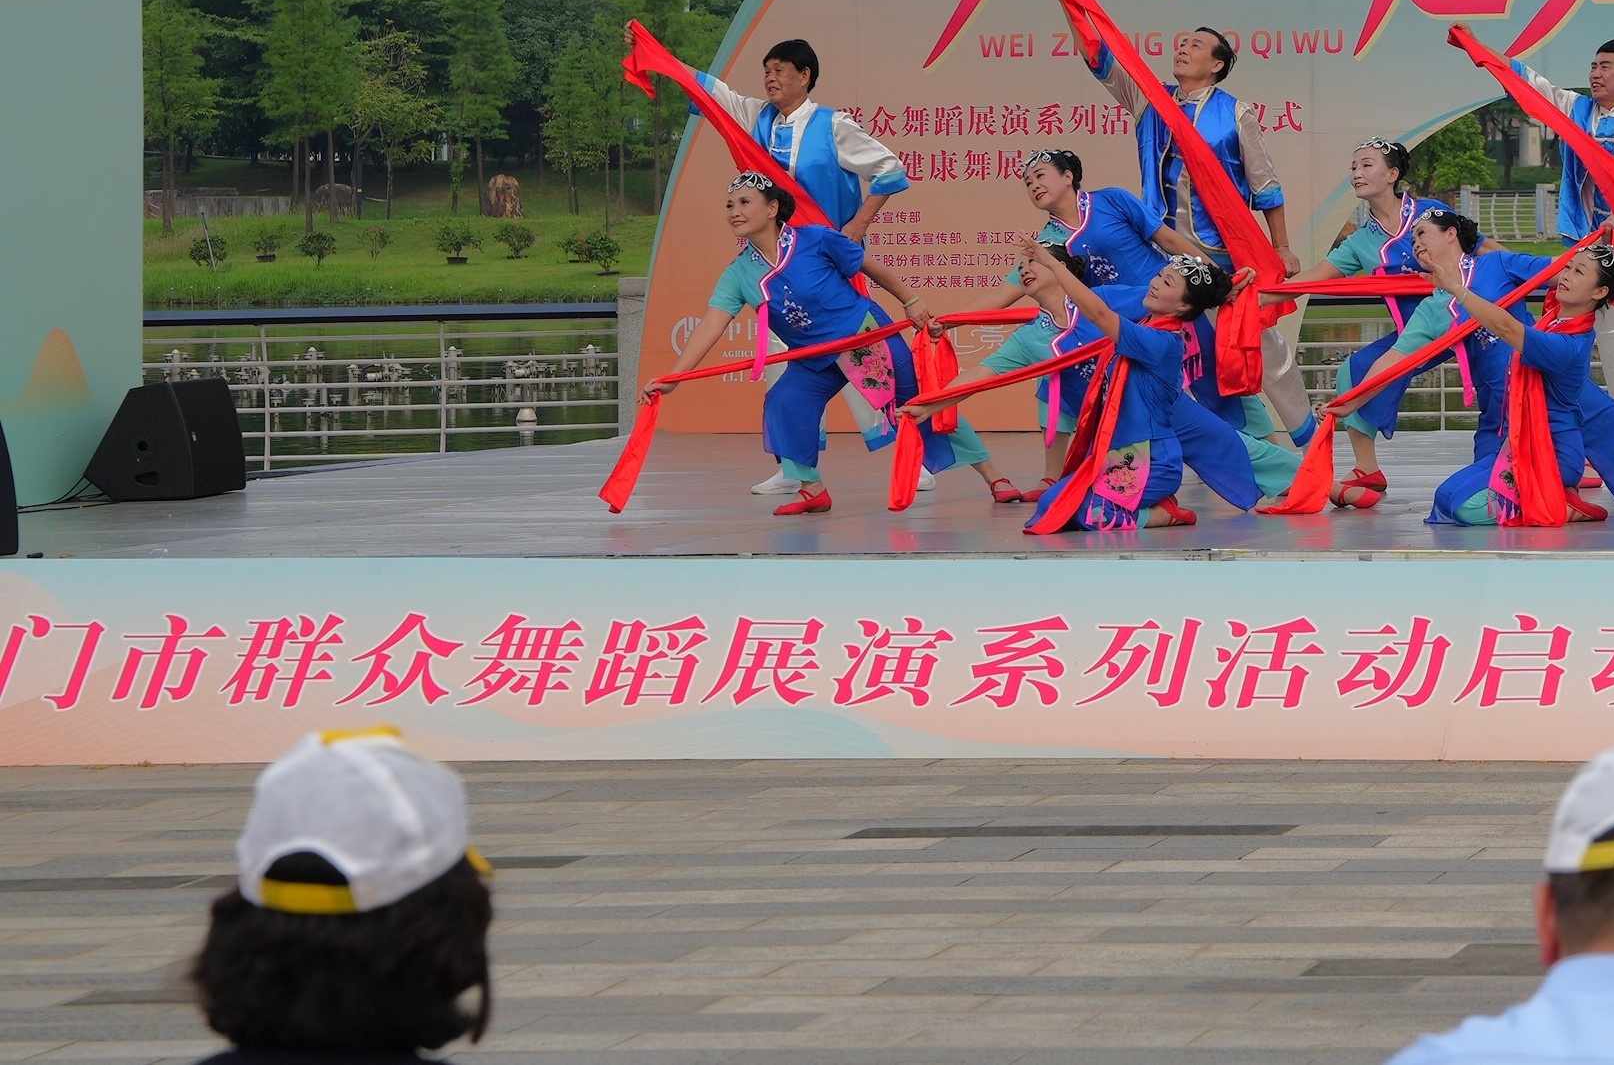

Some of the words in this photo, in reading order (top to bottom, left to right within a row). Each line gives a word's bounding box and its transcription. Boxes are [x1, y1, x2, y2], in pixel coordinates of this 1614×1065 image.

[978, 33, 1034, 58] WEI
[1250, 30, 1283, 59] QI
[1291, 29, 1344, 54] WU
[897, 148, 1047, 182] 健康舞展
[869, 275, 1008, 289] 艺术发展有限公
[722, 349, 756, 358] AGRICU
